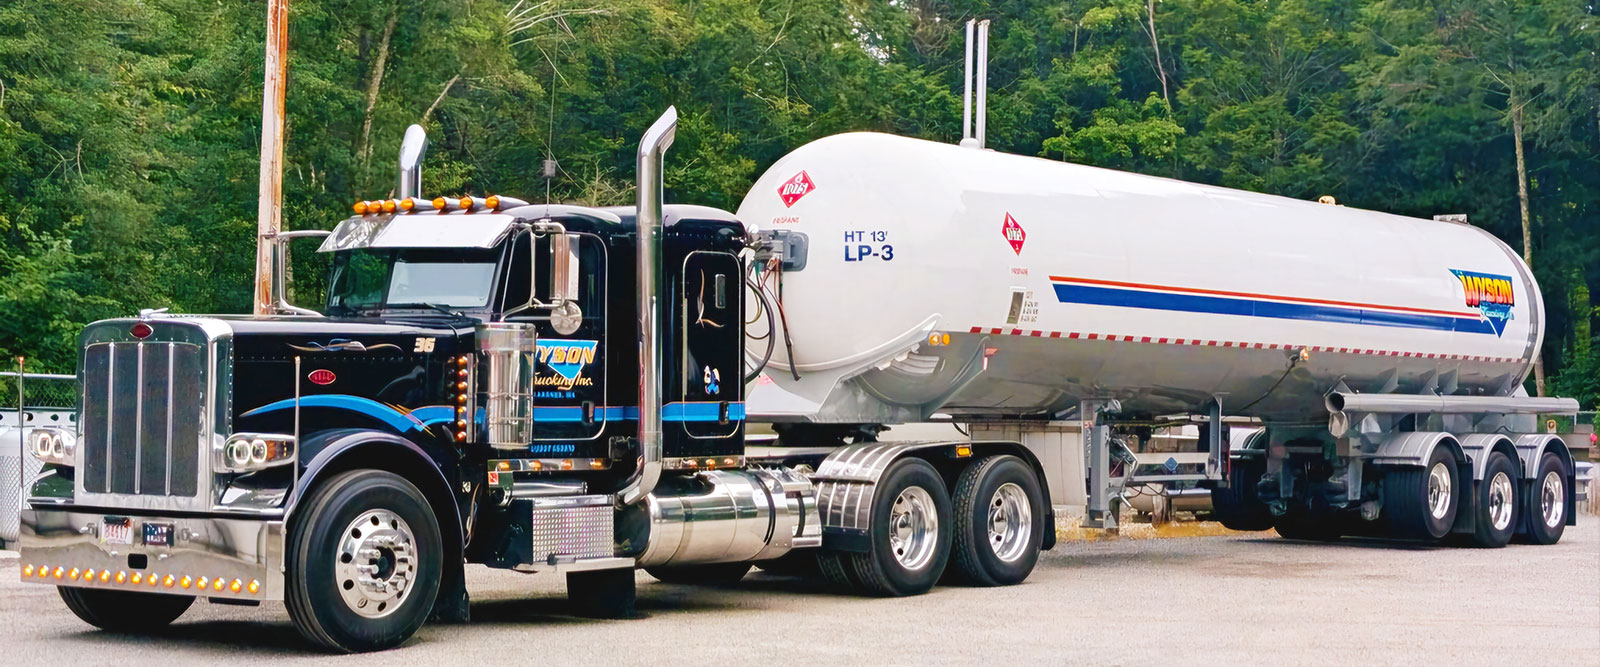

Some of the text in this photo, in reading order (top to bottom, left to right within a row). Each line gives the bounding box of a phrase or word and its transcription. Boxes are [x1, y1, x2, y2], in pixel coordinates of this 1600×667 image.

[844, 230, 888, 243] HT 13'
[844, 244, 894, 262] LP-3
[1459, 274, 1515, 308] WYSON
[413, 337, 436, 353] 36
